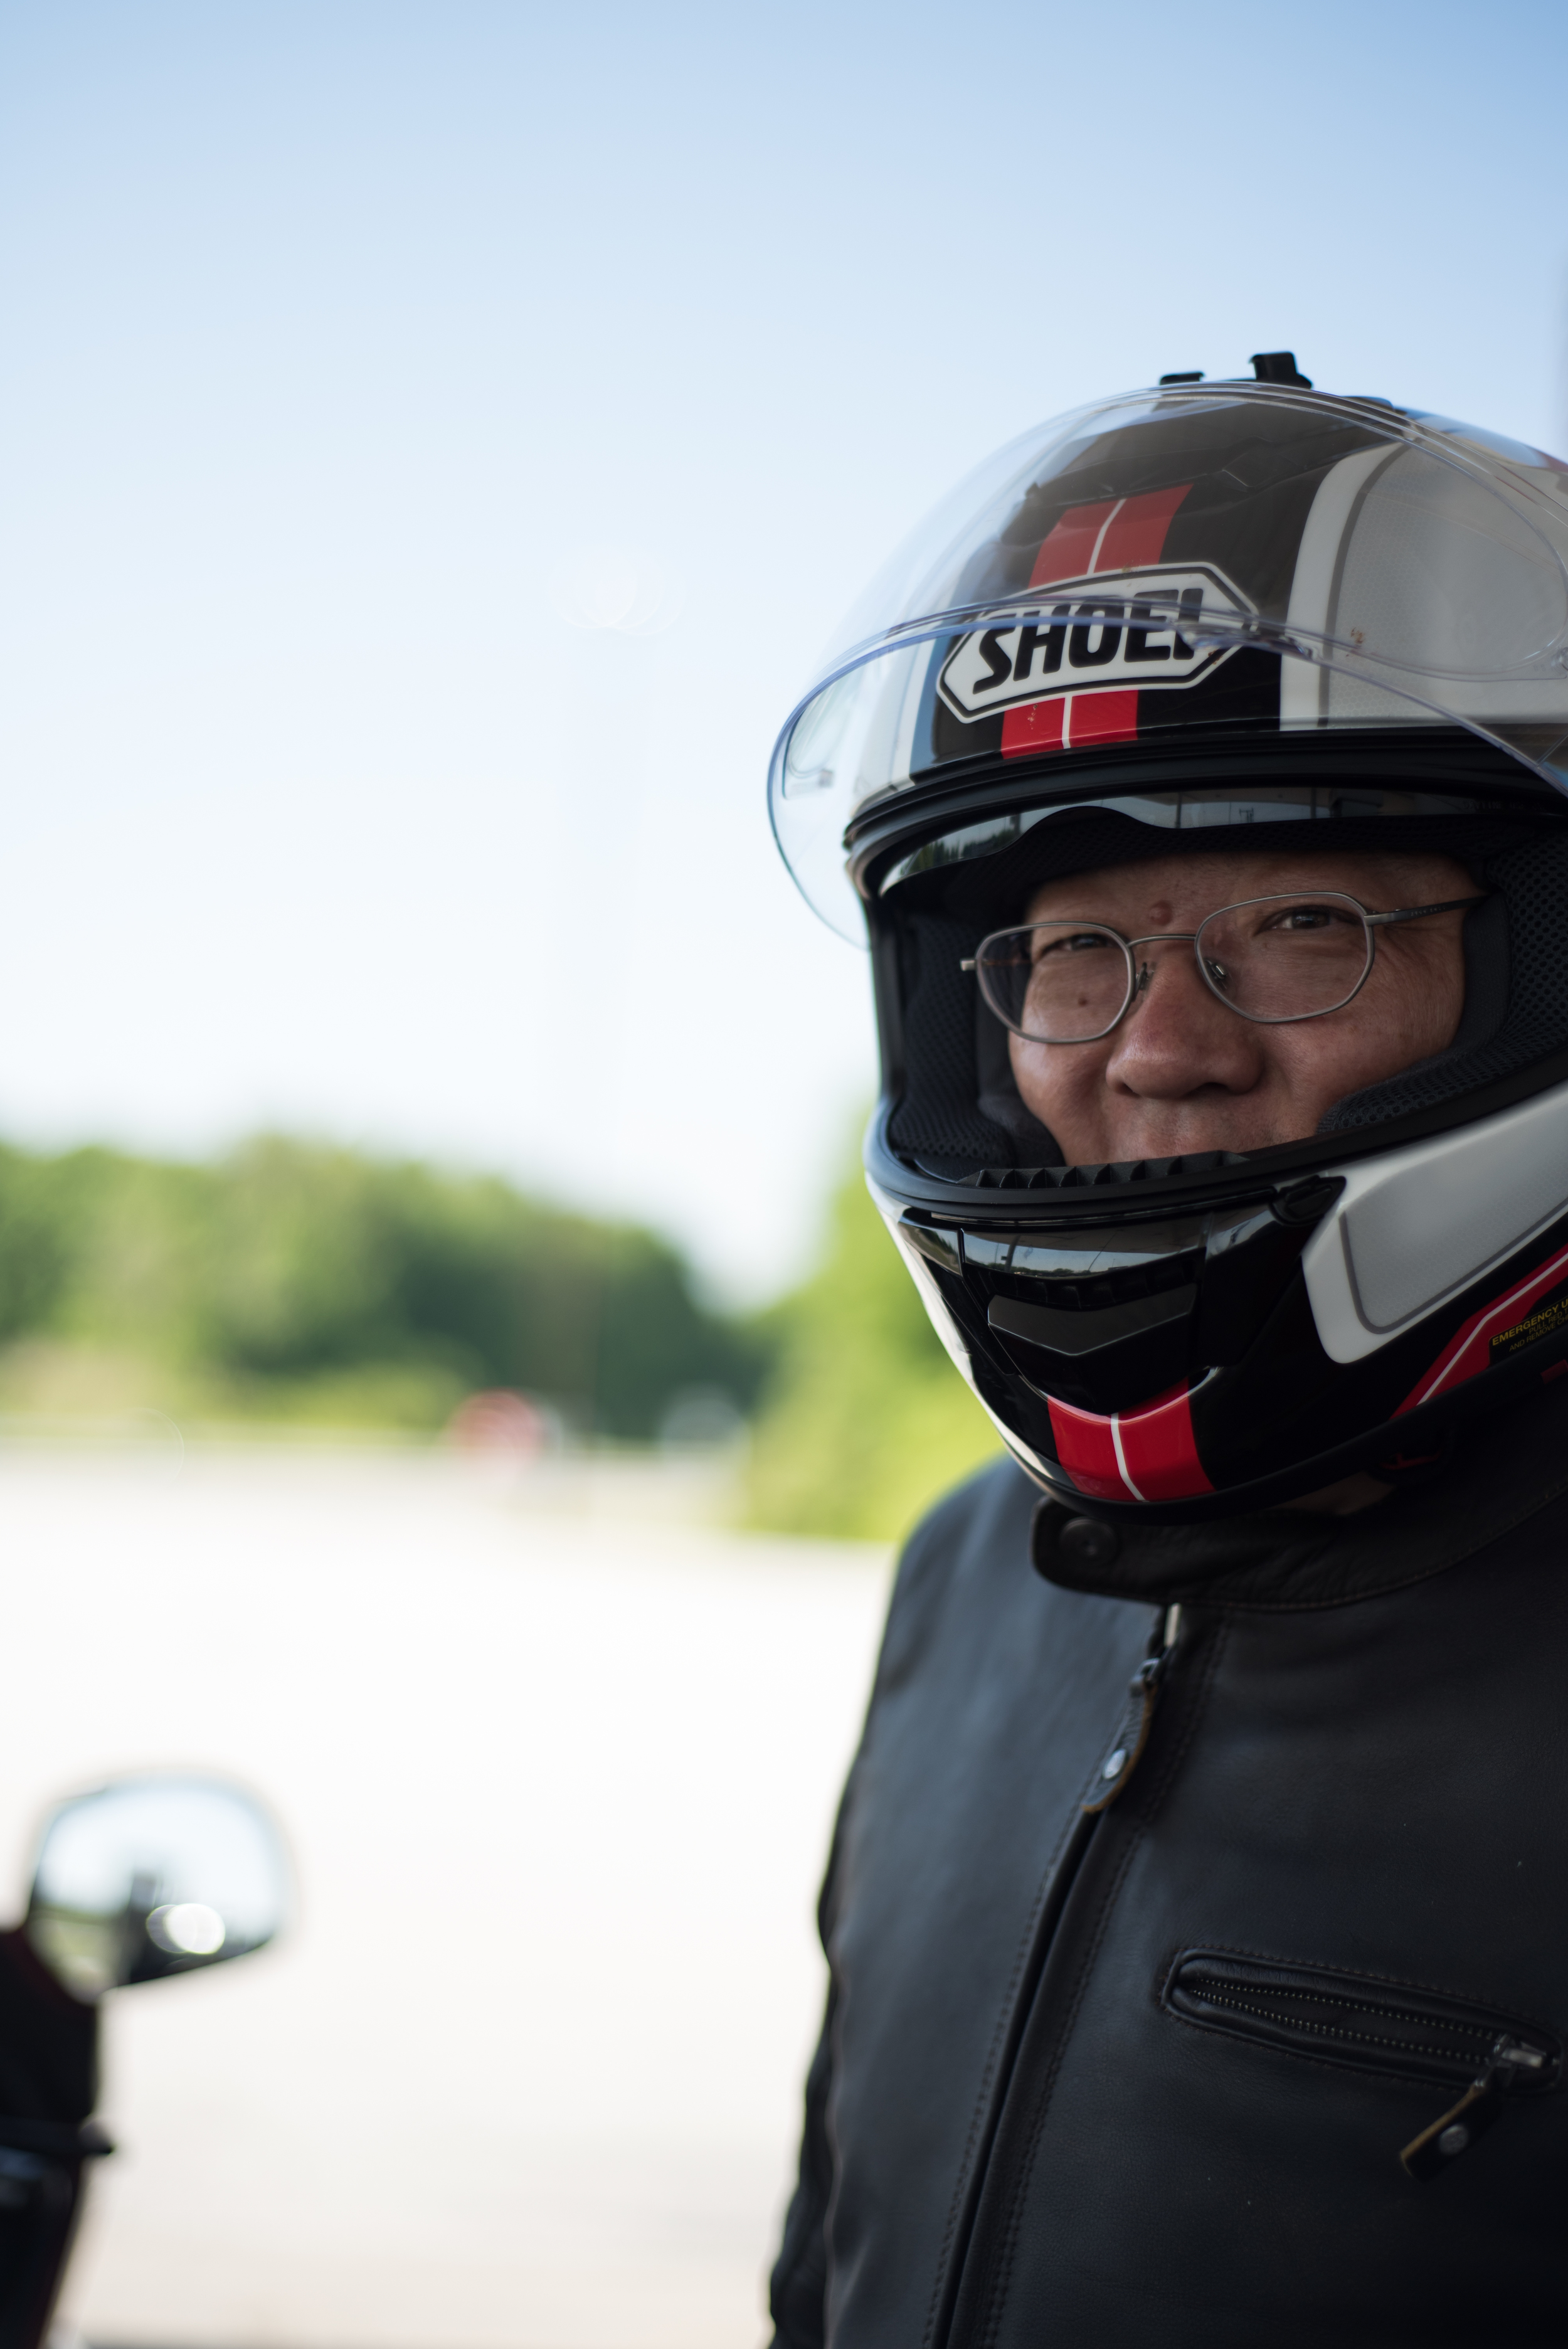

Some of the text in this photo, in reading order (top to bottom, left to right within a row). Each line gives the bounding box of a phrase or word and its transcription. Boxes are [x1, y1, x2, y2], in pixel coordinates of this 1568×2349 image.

[972, 588, 1204, 694] SHOEI
[1492, 1304, 1559, 1346] EMERGENCY
[1509, 1339, 1525, 1352] AND
[1526, 1322, 1555, 1343] REMOVE
[1529, 1321, 1547, 1335] PULL
[1549, 1312, 1562, 1323] RED
